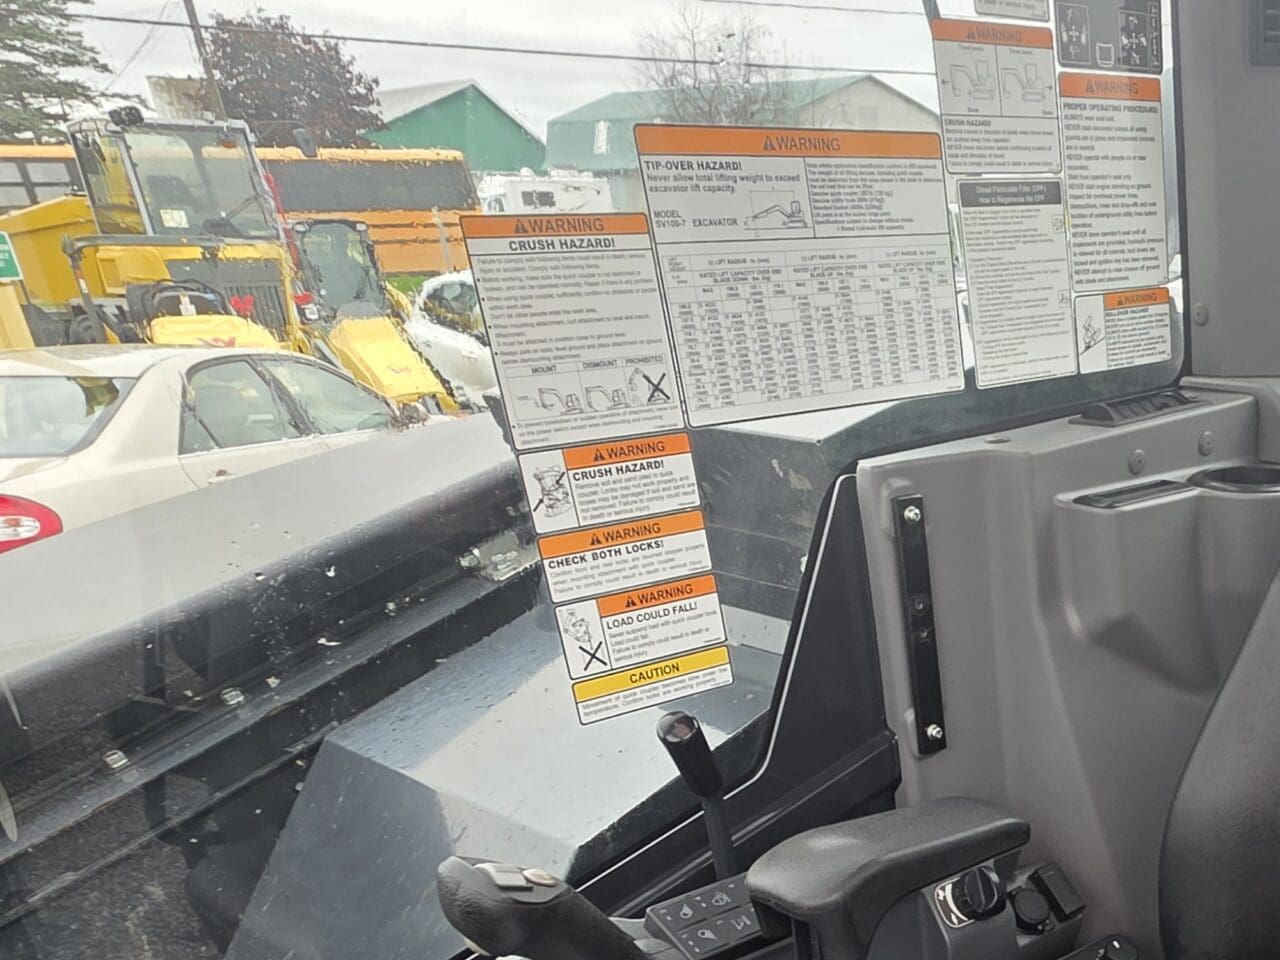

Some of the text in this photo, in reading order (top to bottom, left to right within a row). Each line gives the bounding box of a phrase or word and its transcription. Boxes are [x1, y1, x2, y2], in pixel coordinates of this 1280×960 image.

[977, 28, 1022, 42] WARNING
[1094, 80, 1138, 94] WARNING
[775, 136, 841, 151] WARNING
[643, 160, 742, 170] TIP-OVER HAZARD!
[646, 174, 800, 183] Never allow total lifting weight to exceed
[648, 184, 736, 193] excavator lift capacity.
[652, 209, 680, 218] MODEL
[527, 218, 605, 233] WARNING
[692, 218, 738, 226] EXCAVATOR
[508, 238, 615, 251] CRUSH HAZARD!
[582, 359, 617, 368] DISMOUNT
[624, 355, 663, 364] PROHIBITED
[531, 365, 557, 373] MOUNT
[605, 440, 665, 458] WARNING
[572, 459, 664, 481] CRUSH HAZARD!
[602, 522, 661, 543] WARNING
[547, 539, 664, 570] CHECK BOTH LOCKS!
[637, 583, 693, 605] WARNING
[605, 601, 697, 630] LOAD COULD FALL!
[628, 662, 680, 683] CAUTION
